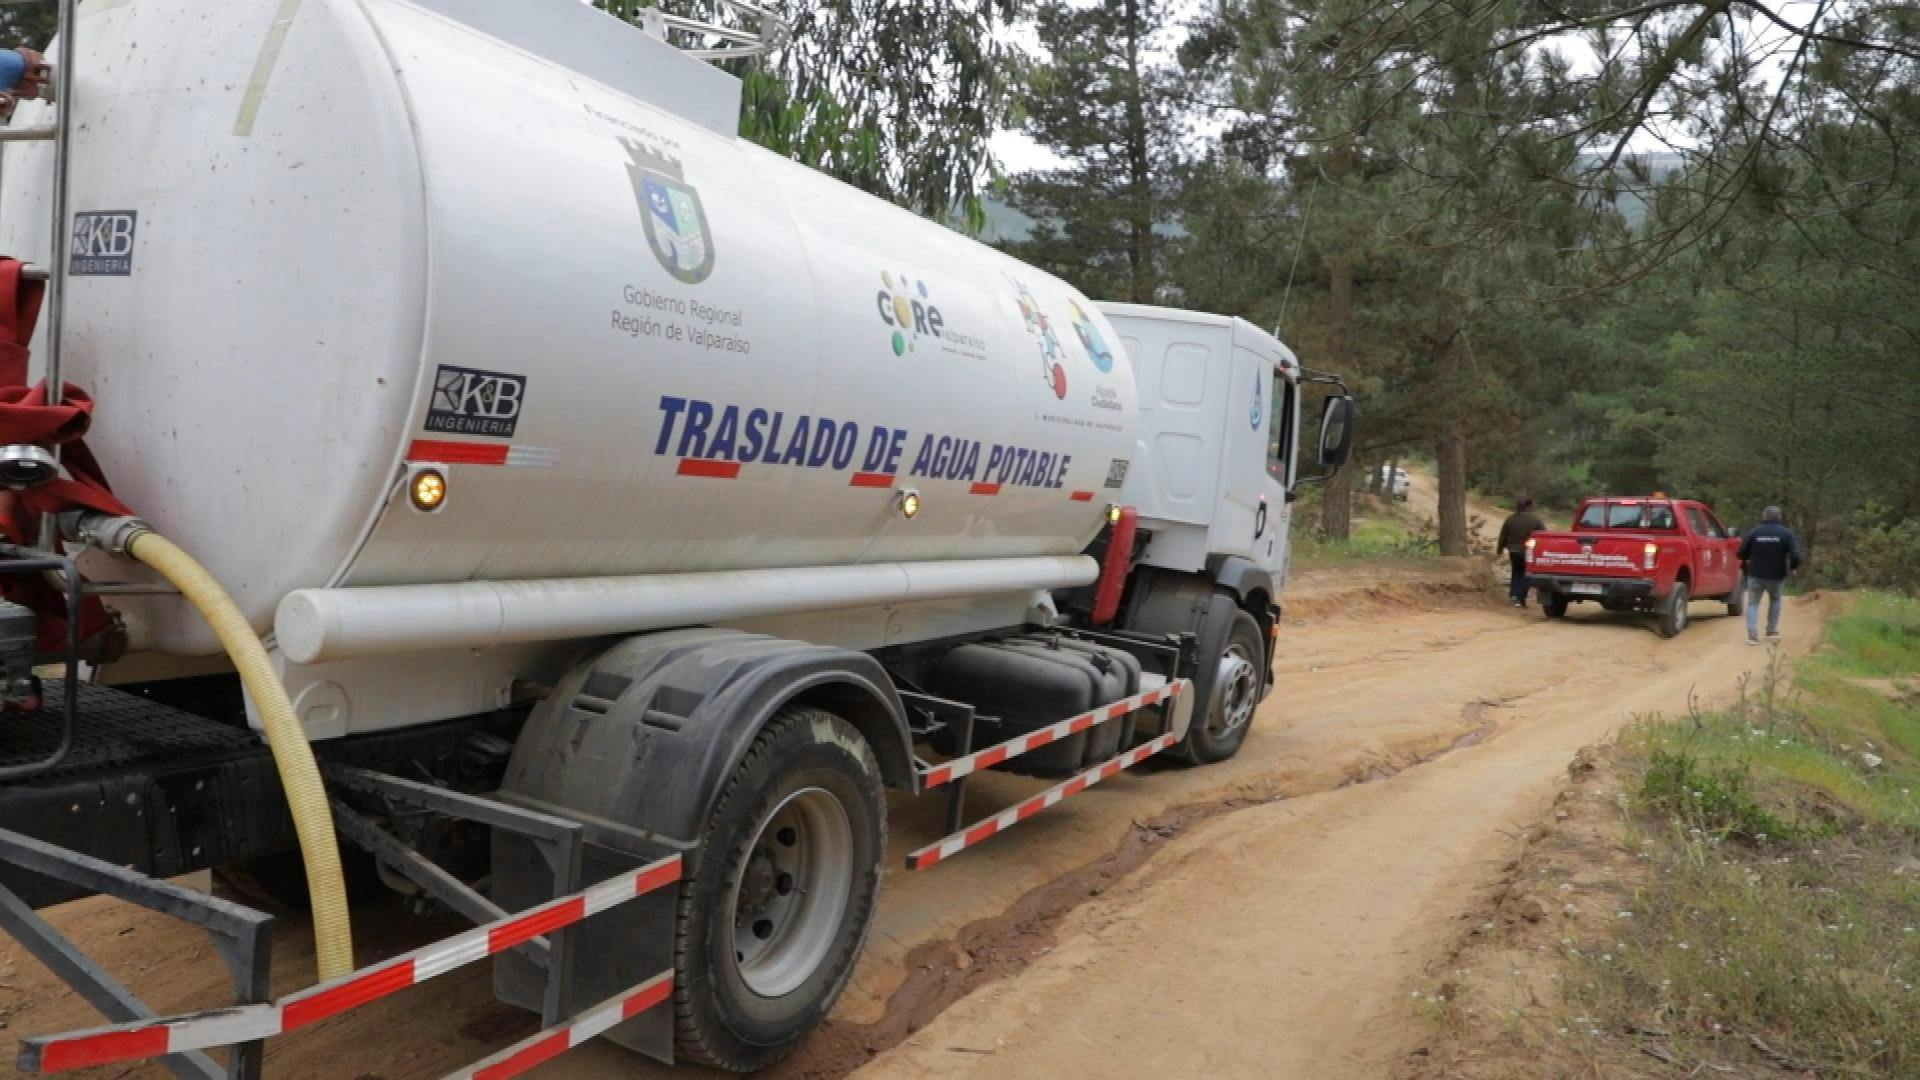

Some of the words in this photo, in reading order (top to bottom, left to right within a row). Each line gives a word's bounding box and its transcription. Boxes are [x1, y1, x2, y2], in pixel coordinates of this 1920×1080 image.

[611, 309, 661, 338] Región
[666, 322, 683, 341] de
[623, 284, 686, 315] Gobierno
[690, 299, 742, 327] Regional
[453, 373, 521, 418] K&B
[427, 415, 513, 434] INGENIERIA
[654, 395, 859, 471] TRASLADO
[861, 425, 908, 474] DE
[909, 433, 981, 482] AGUA
[981, 444, 1072, 489] POTABLE
